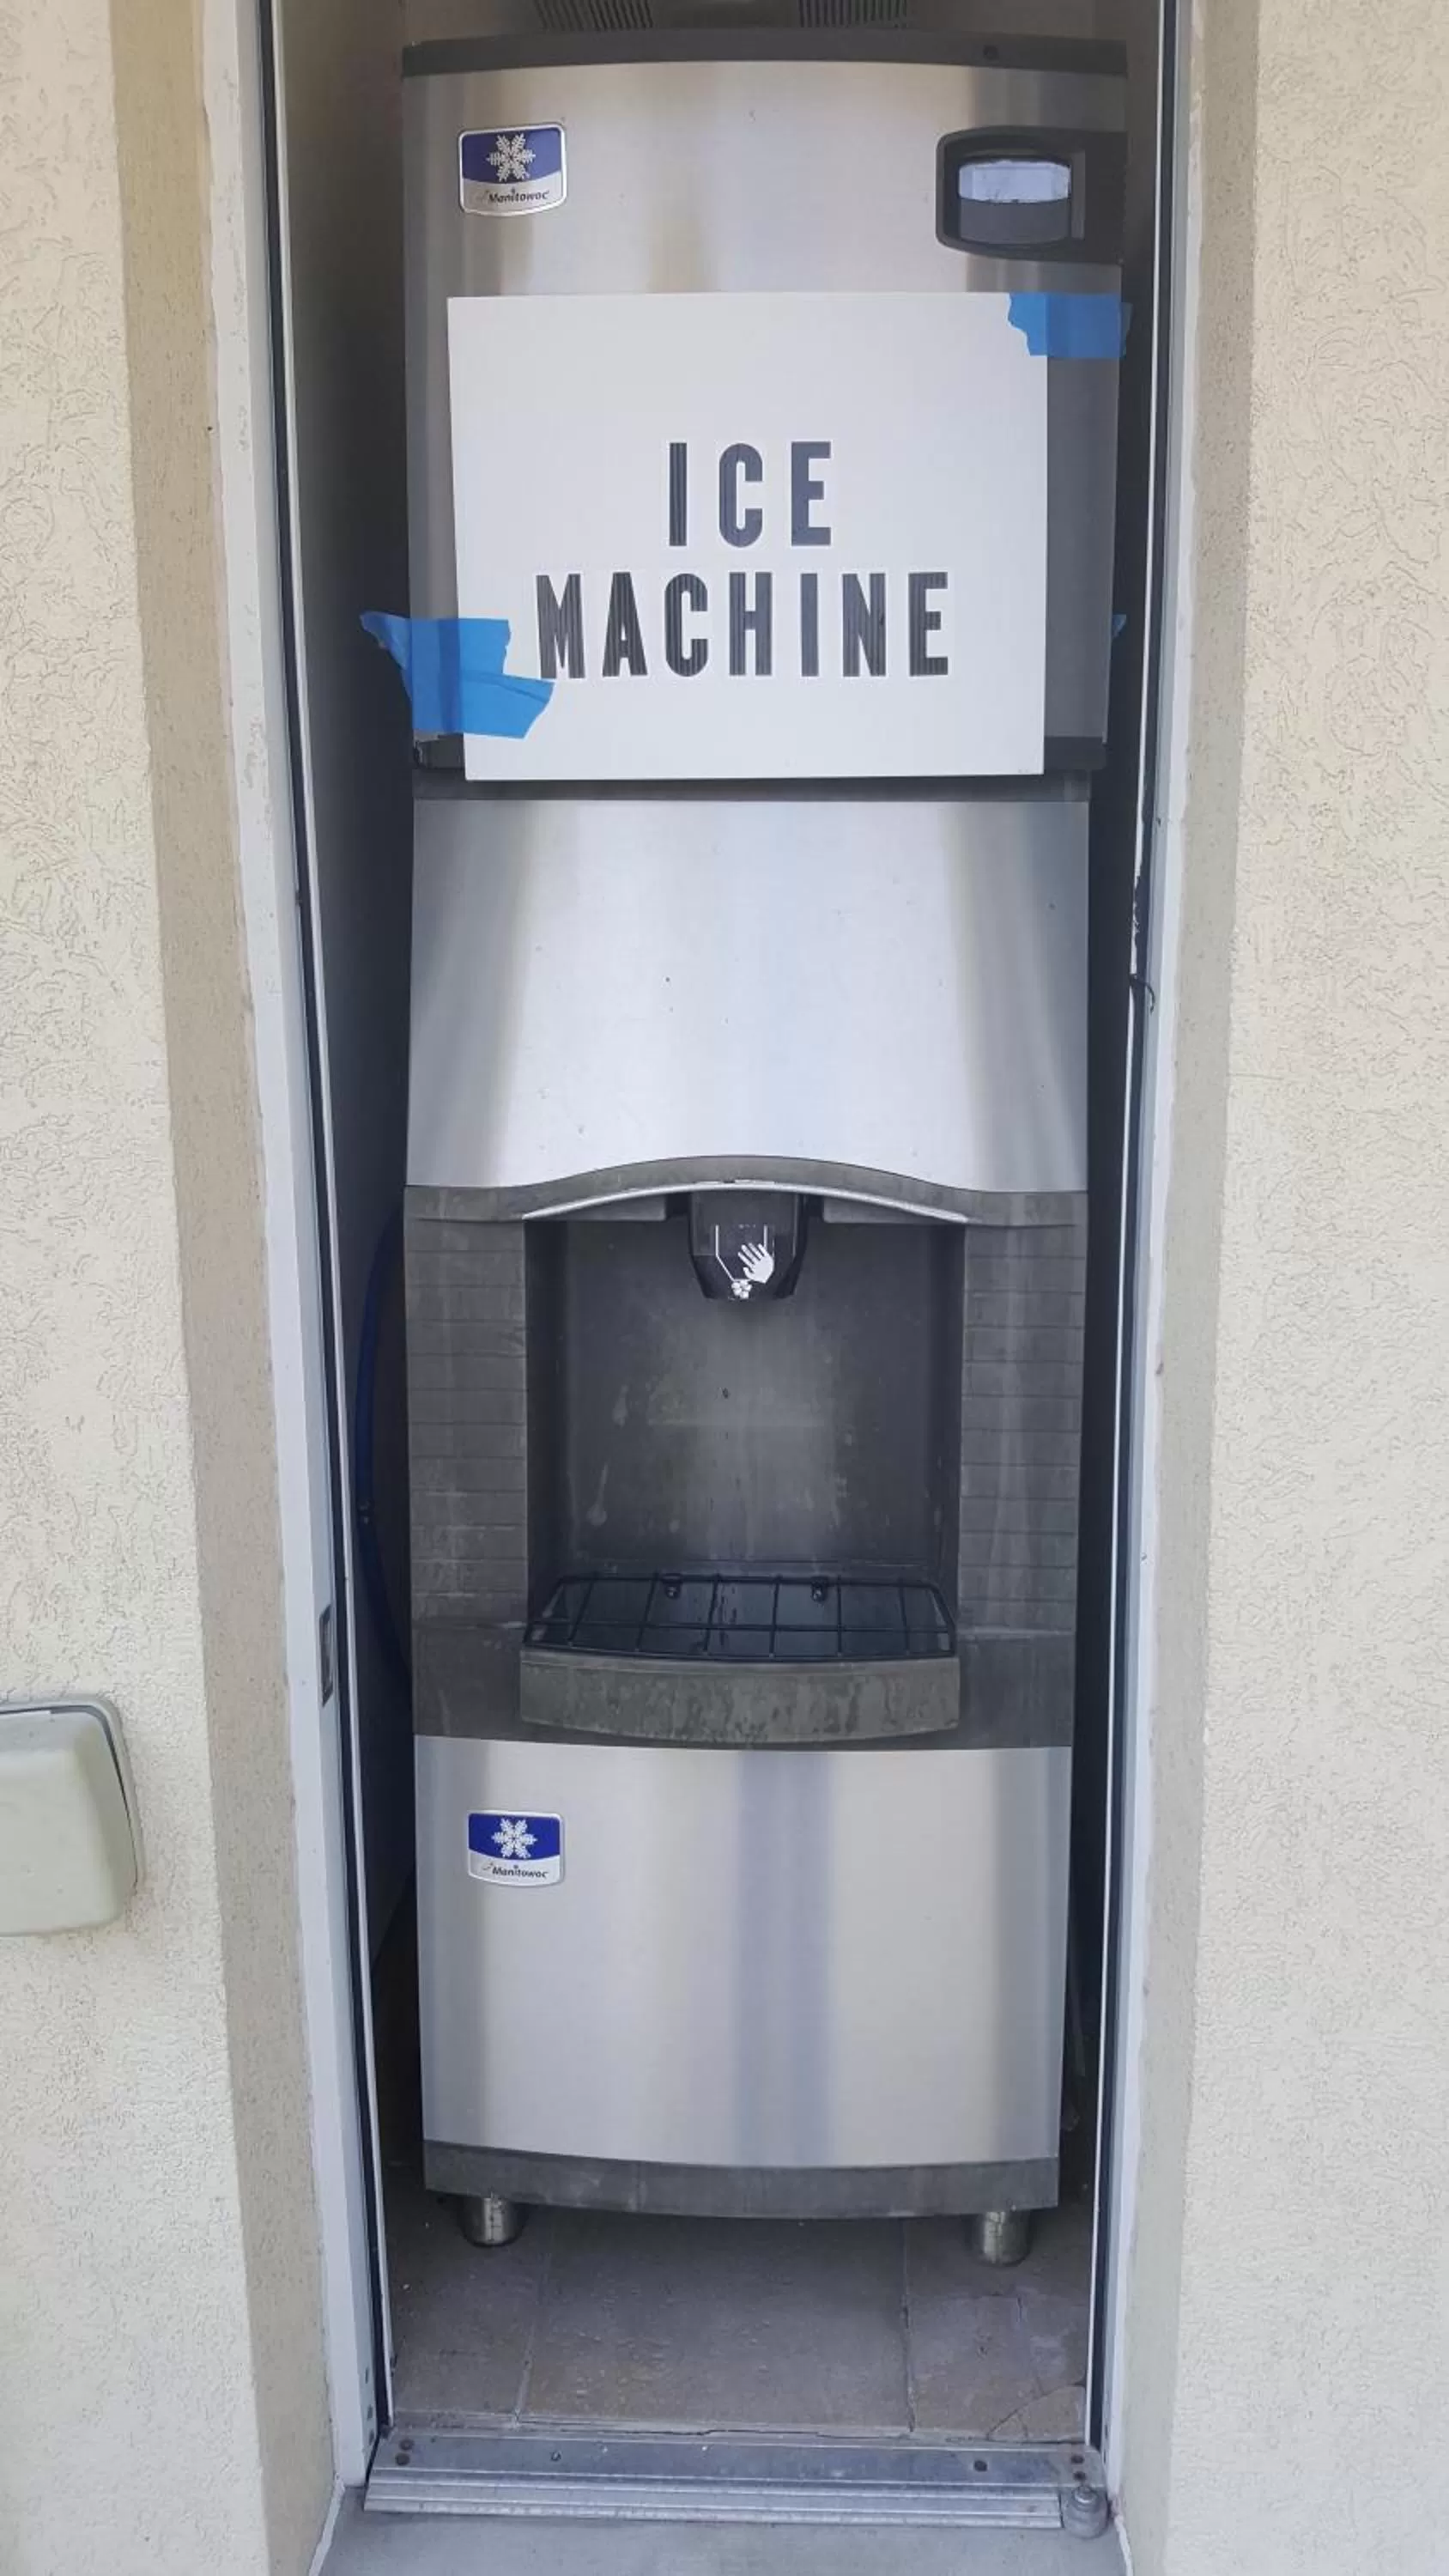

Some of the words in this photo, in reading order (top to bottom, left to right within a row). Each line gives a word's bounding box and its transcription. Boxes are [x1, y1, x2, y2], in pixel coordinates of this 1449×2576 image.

[488, 187, 549, 204] Manitowoc
[669, 441, 832, 547] ICE
[537, 572, 949, 678] MACHINE
[492, 1864, 549, 1878] Manitowoc
